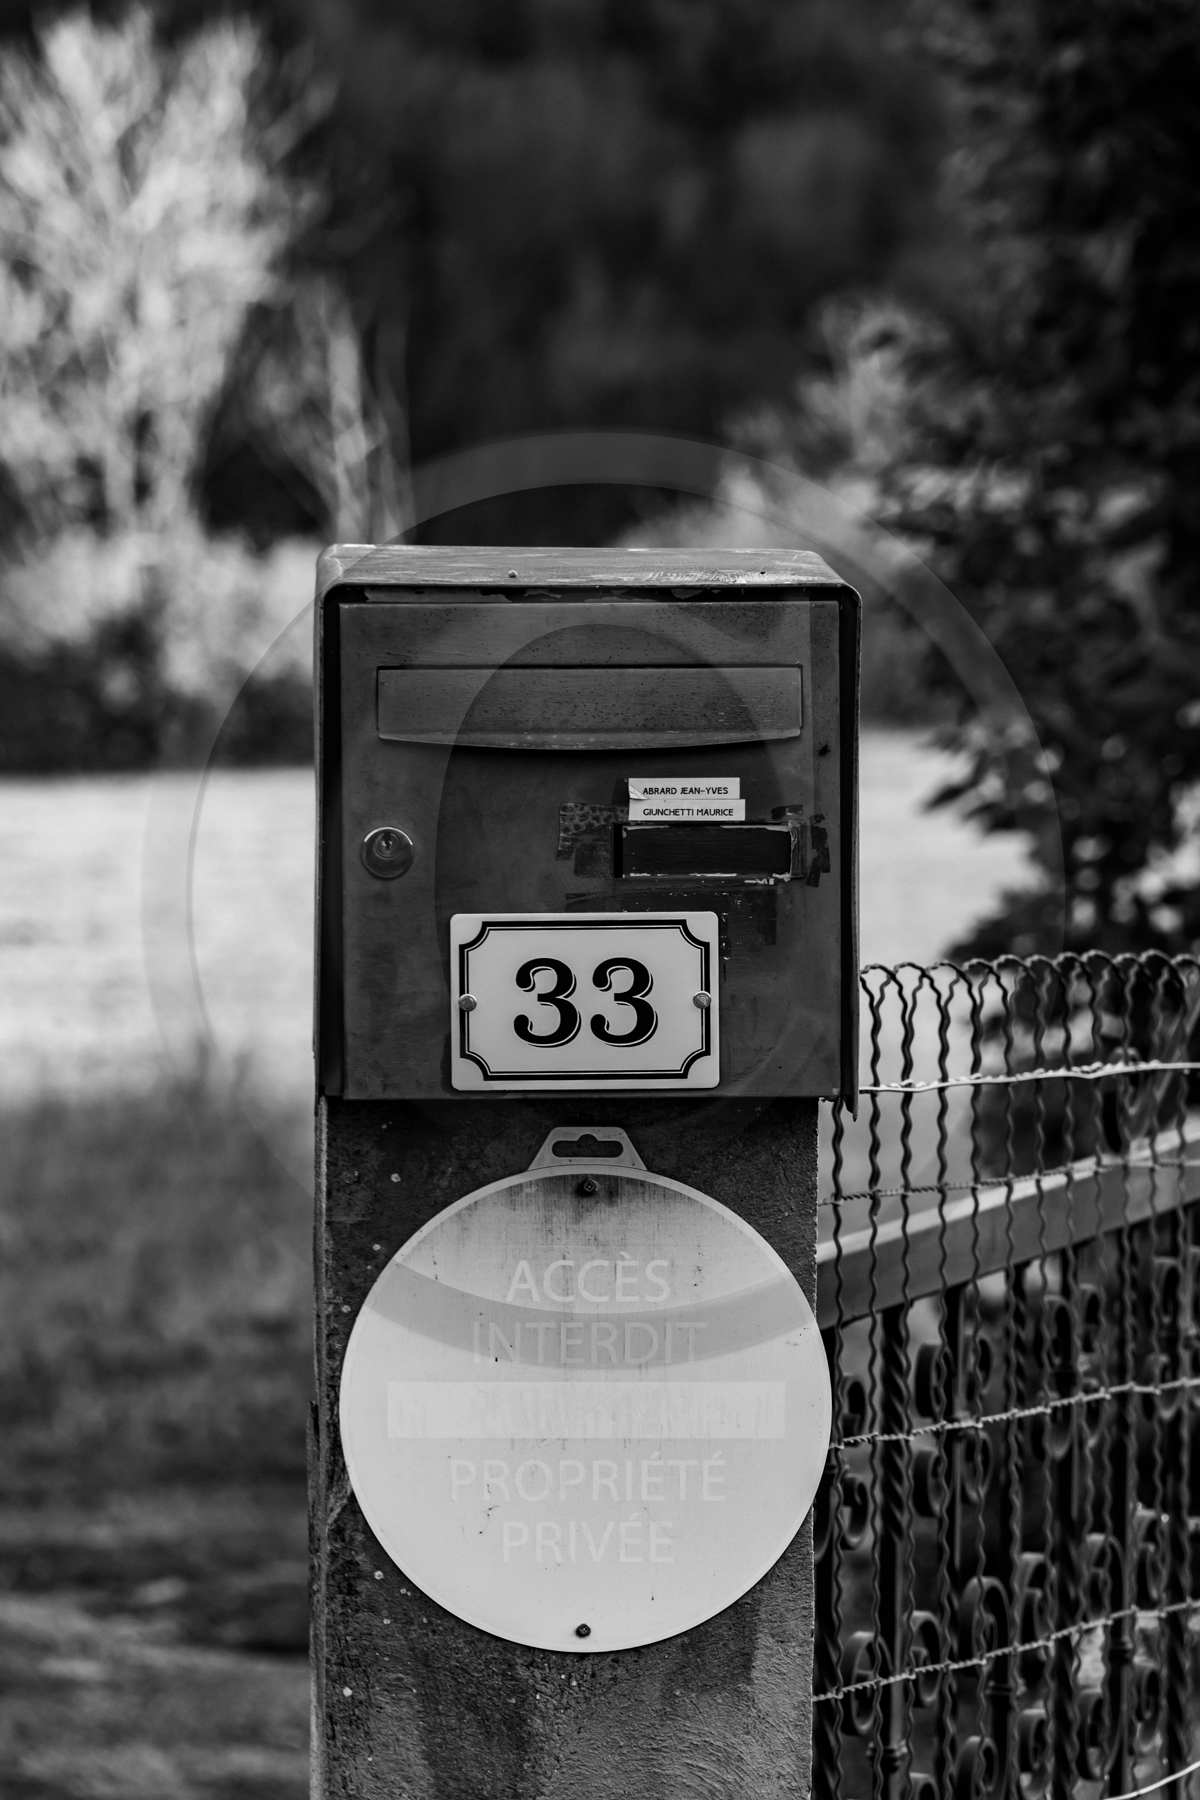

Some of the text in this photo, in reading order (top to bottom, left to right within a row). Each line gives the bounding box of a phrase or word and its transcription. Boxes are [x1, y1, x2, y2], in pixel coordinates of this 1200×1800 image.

[642, 787, 729, 795] ABRARD JEAN-YVES
[642, 808, 734, 816] GIUNCHETTI MAURICE
[513, 957, 659, 1048] 33
[505, 1251, 671, 1304] ACCÈS
[472, 1321, 708, 1365] INTERDIT
[450, 1450, 728, 1503] PROPRIÉTÉ
[501, 1512, 676, 1564] PRIVÉE
